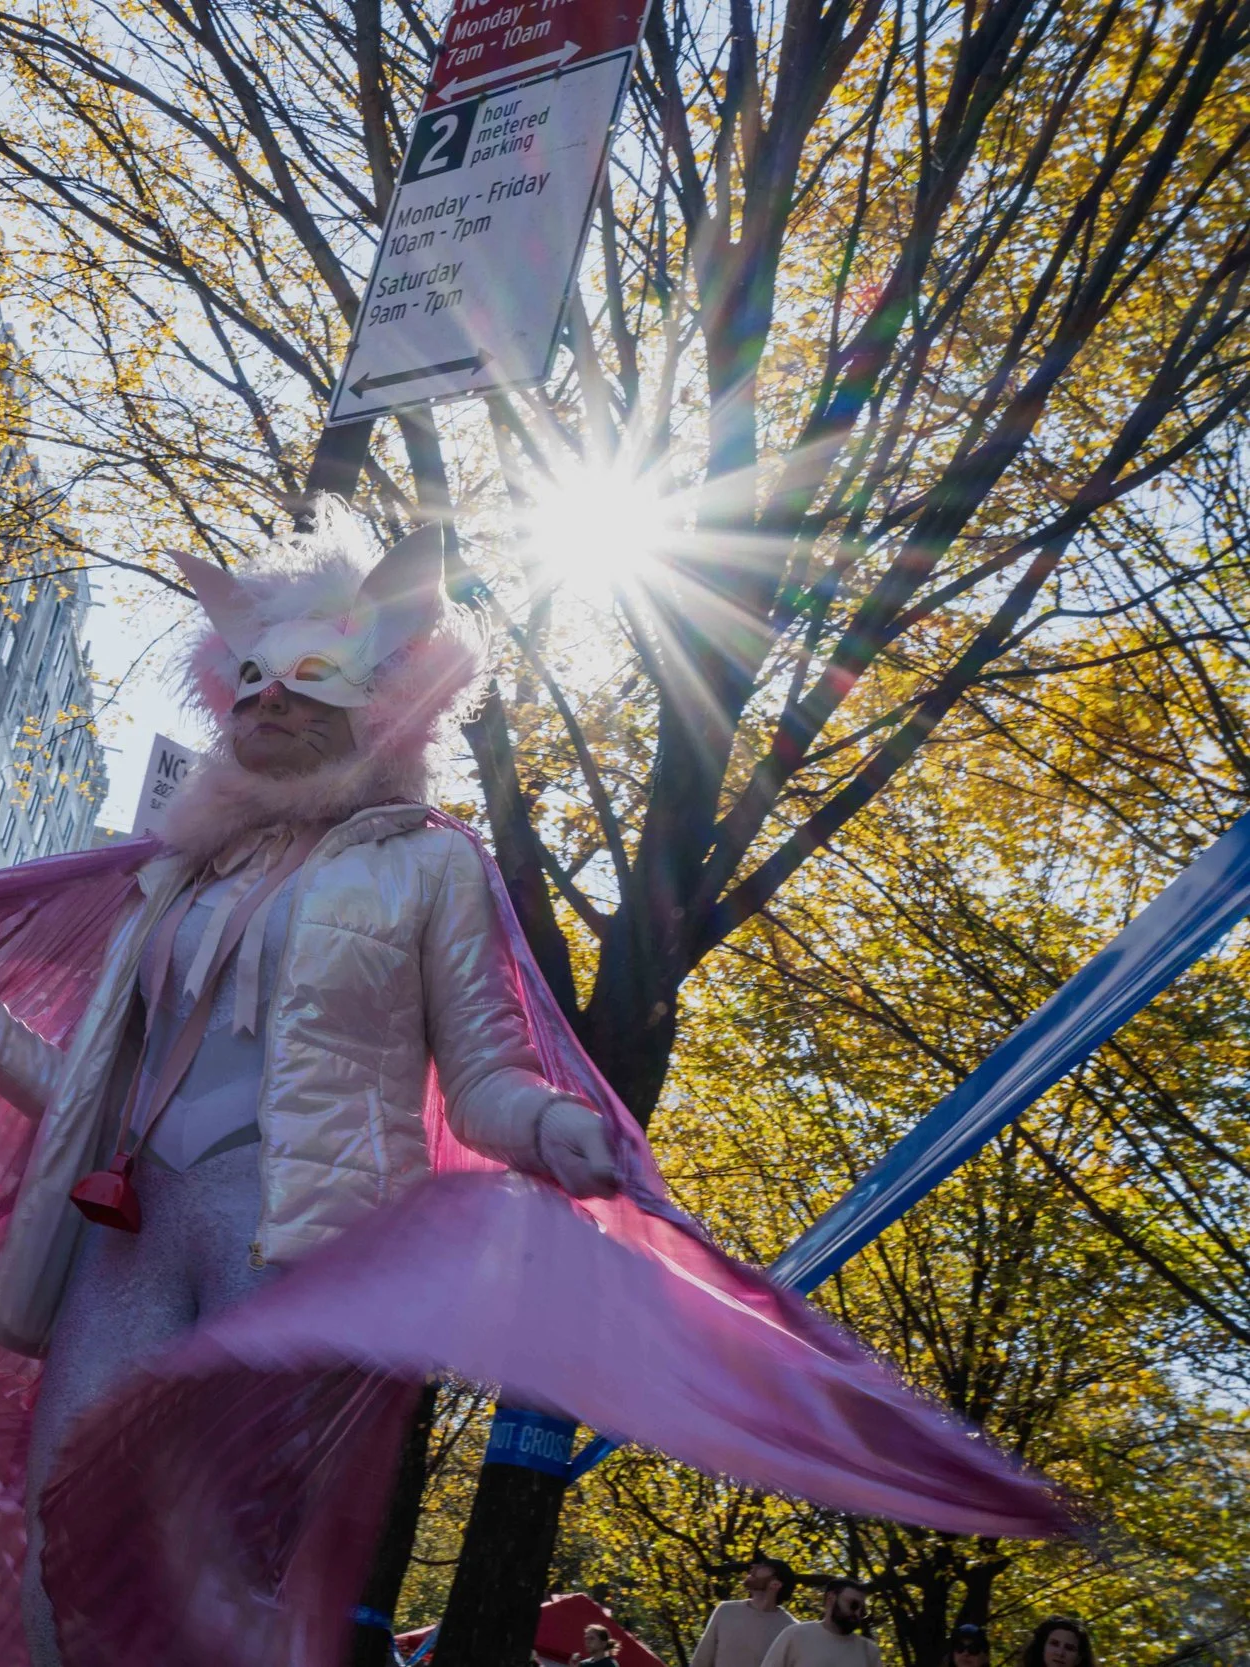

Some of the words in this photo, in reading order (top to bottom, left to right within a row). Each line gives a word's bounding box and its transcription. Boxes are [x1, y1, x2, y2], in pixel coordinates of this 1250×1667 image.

[451, 3, 526, 43] Monday
[445, 43, 485, 70] 7am
[502, 20, 551, 50] 10am
[476, 106, 551, 144] metered
[482, 100, 523, 124] hour
[417, 114, 459, 175] 2
[470, 134, 535, 168] parking
[395, 194, 470, 229] Monday
[487, 171, 551, 204] Friday
[389, 230, 435, 257] 10am
[452, 215, 491, 242] 7pm
[376, 261, 463, 298] Saturday
[368, 302, 407, 327] 9am
[424, 289, 463, 316] 7pm
